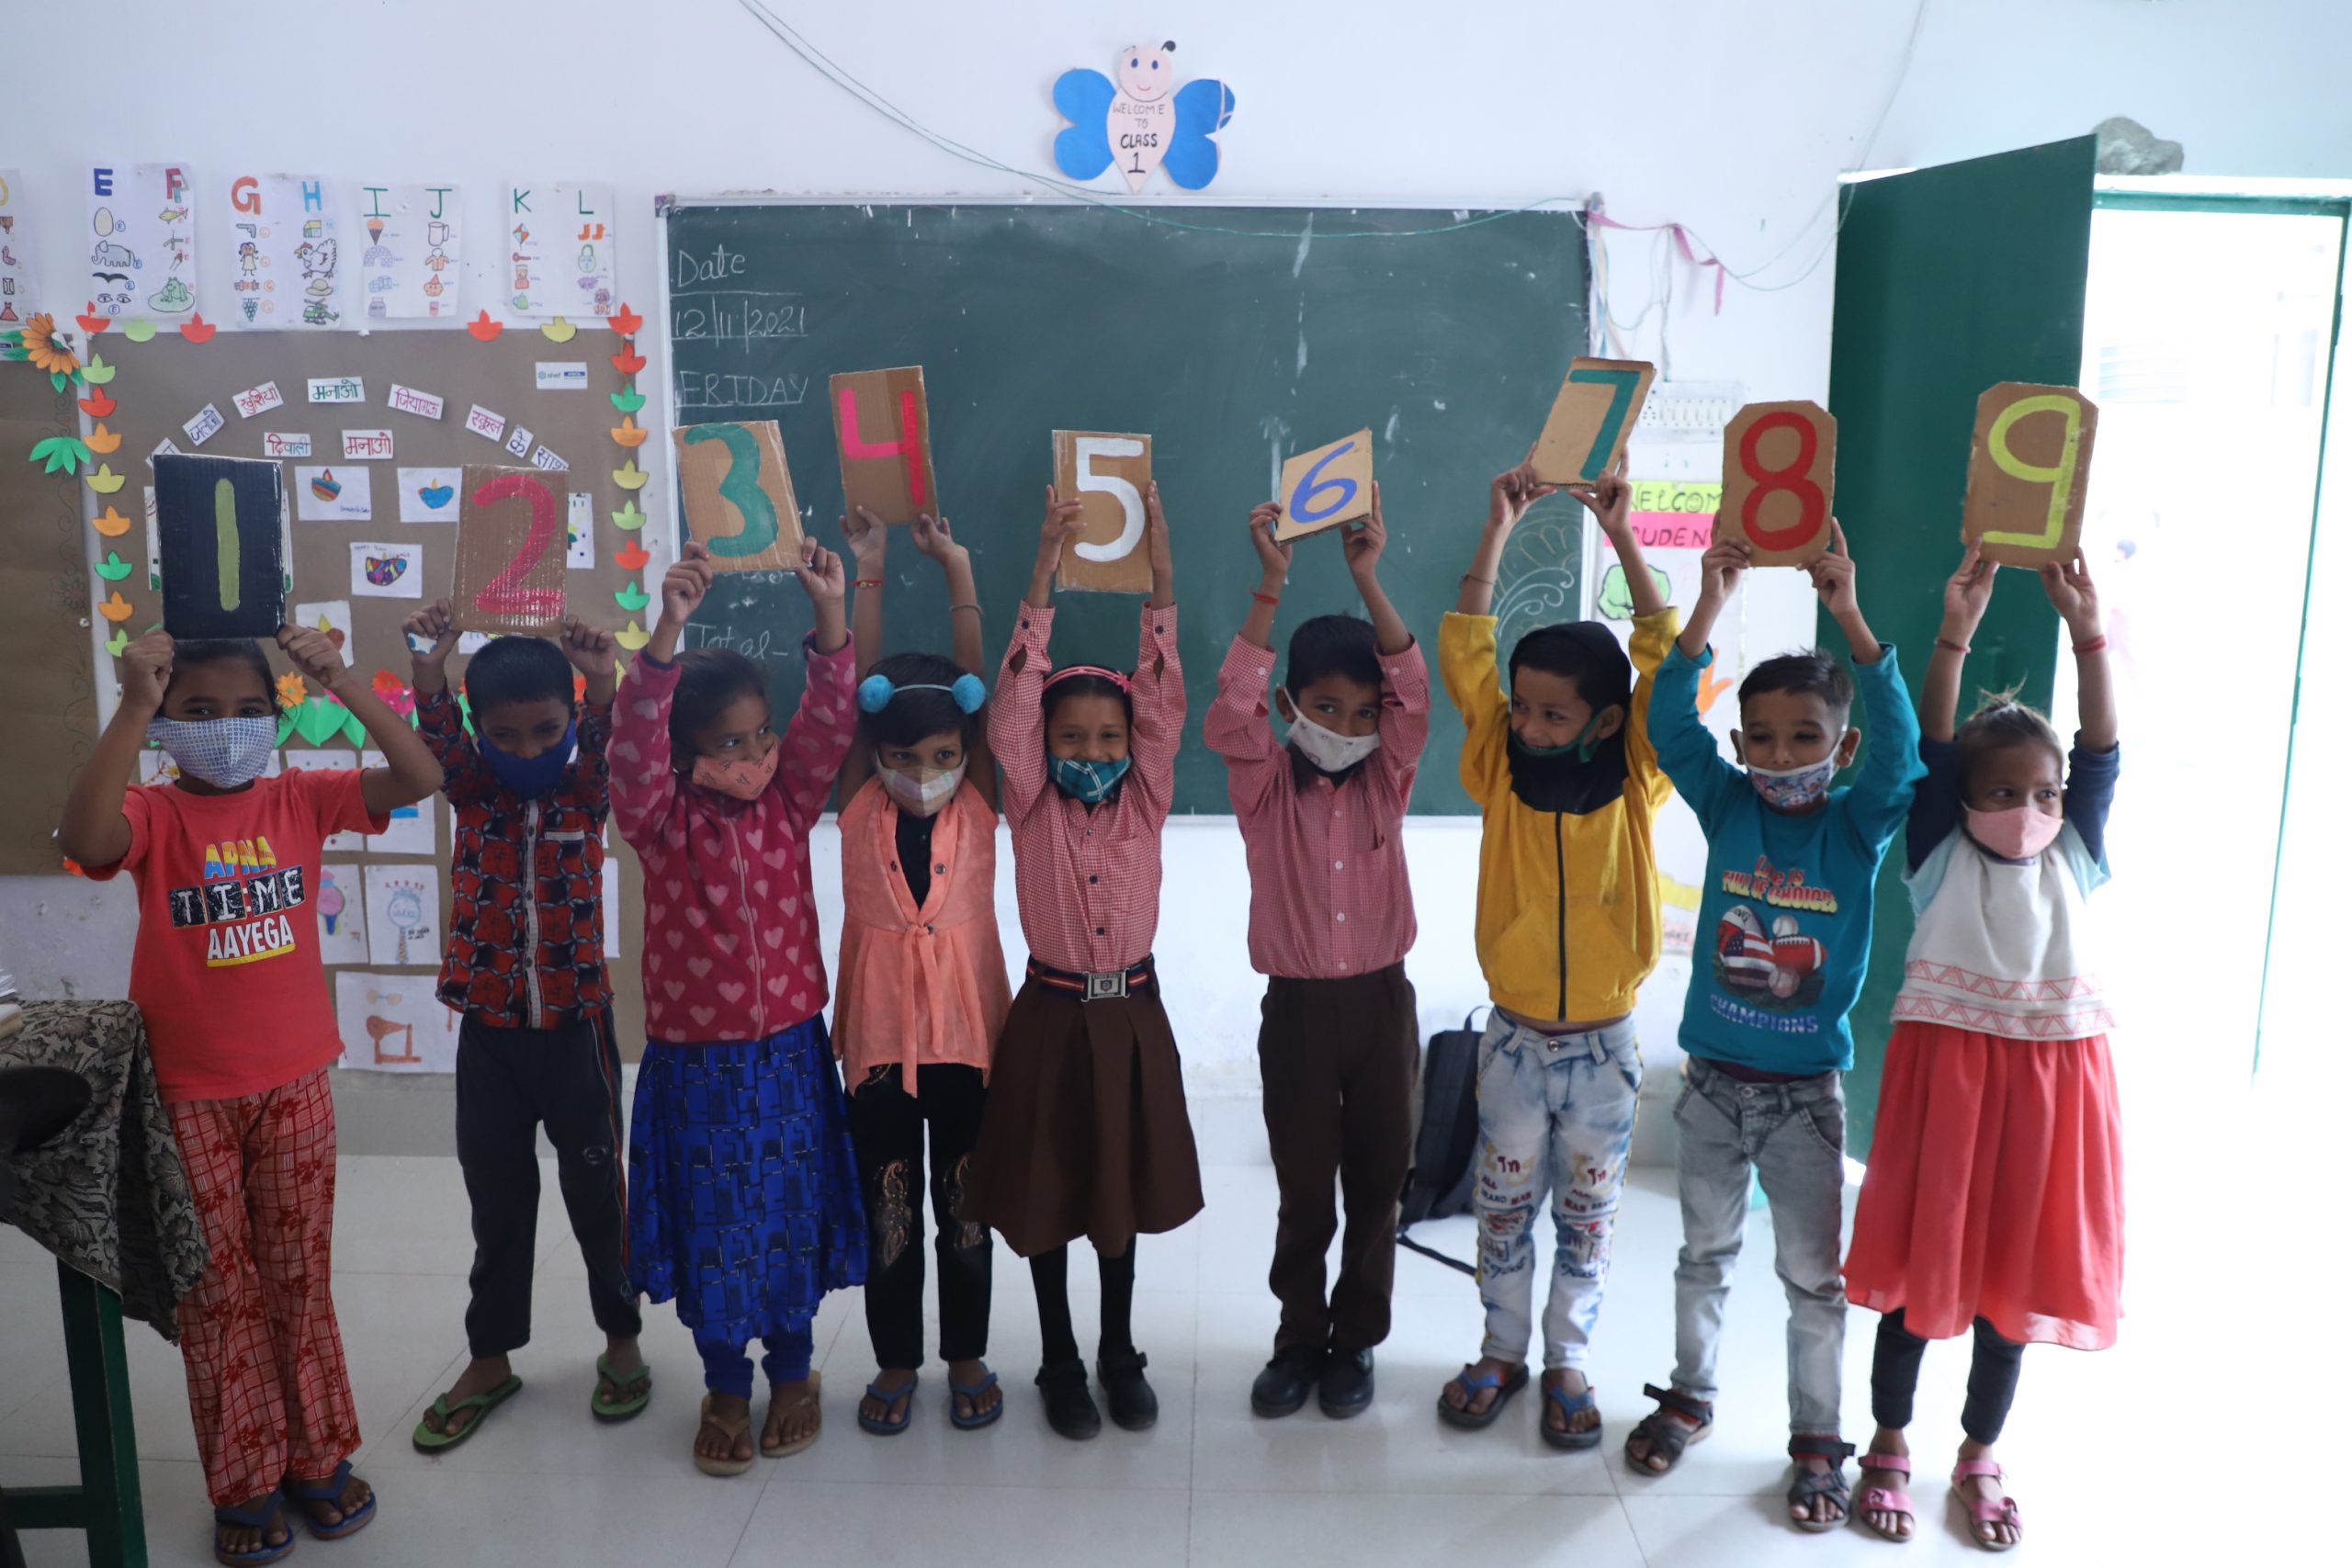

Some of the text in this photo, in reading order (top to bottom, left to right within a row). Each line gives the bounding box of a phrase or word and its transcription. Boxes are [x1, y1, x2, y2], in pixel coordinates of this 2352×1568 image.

[1113, 103, 1166, 115] WELCOME
[1135, 118, 1148, 130] TO
[1120, 133, 1159, 149] CLASS
[94, 167, 113, 197] E
[1127, 152, 1146, 174] 1
[231, 175, 322, 215] G H
[363, 187, 452, 219] I J
[514, 187, 594, 214] K L
[678, 243, 745, 287] Date
[680, 370, 808, 405] FRIDAY
[312, 378, 361, 400] मनाओ
[471, 410, 505, 436] स्कूल
[509, 425, 526, 454] के
[1567, 369, 1641, 480] 7
[266, 432, 392, 457] दिवाली मनाओ
[838, 388, 926, 507] 4
[684, 423, 779, 558] 3
[1289, 441, 1357, 524] 6
[1740, 411, 1825, 551] 8
[1982, 394, 2081, 549] 9
[1074, 436, 1146, 563] 5
[1632, 483, 1723, 513] ELCOM
[215, 478, 240, 612] 1
[473, 475, 565, 617] 2
[1633, 526, 1709, 547] UDEN
[204, 836, 277, 879] APNA
[208, 915, 295, 960] AAYEGA
[1710, 994, 1818, 1033] CHAMPIONS
